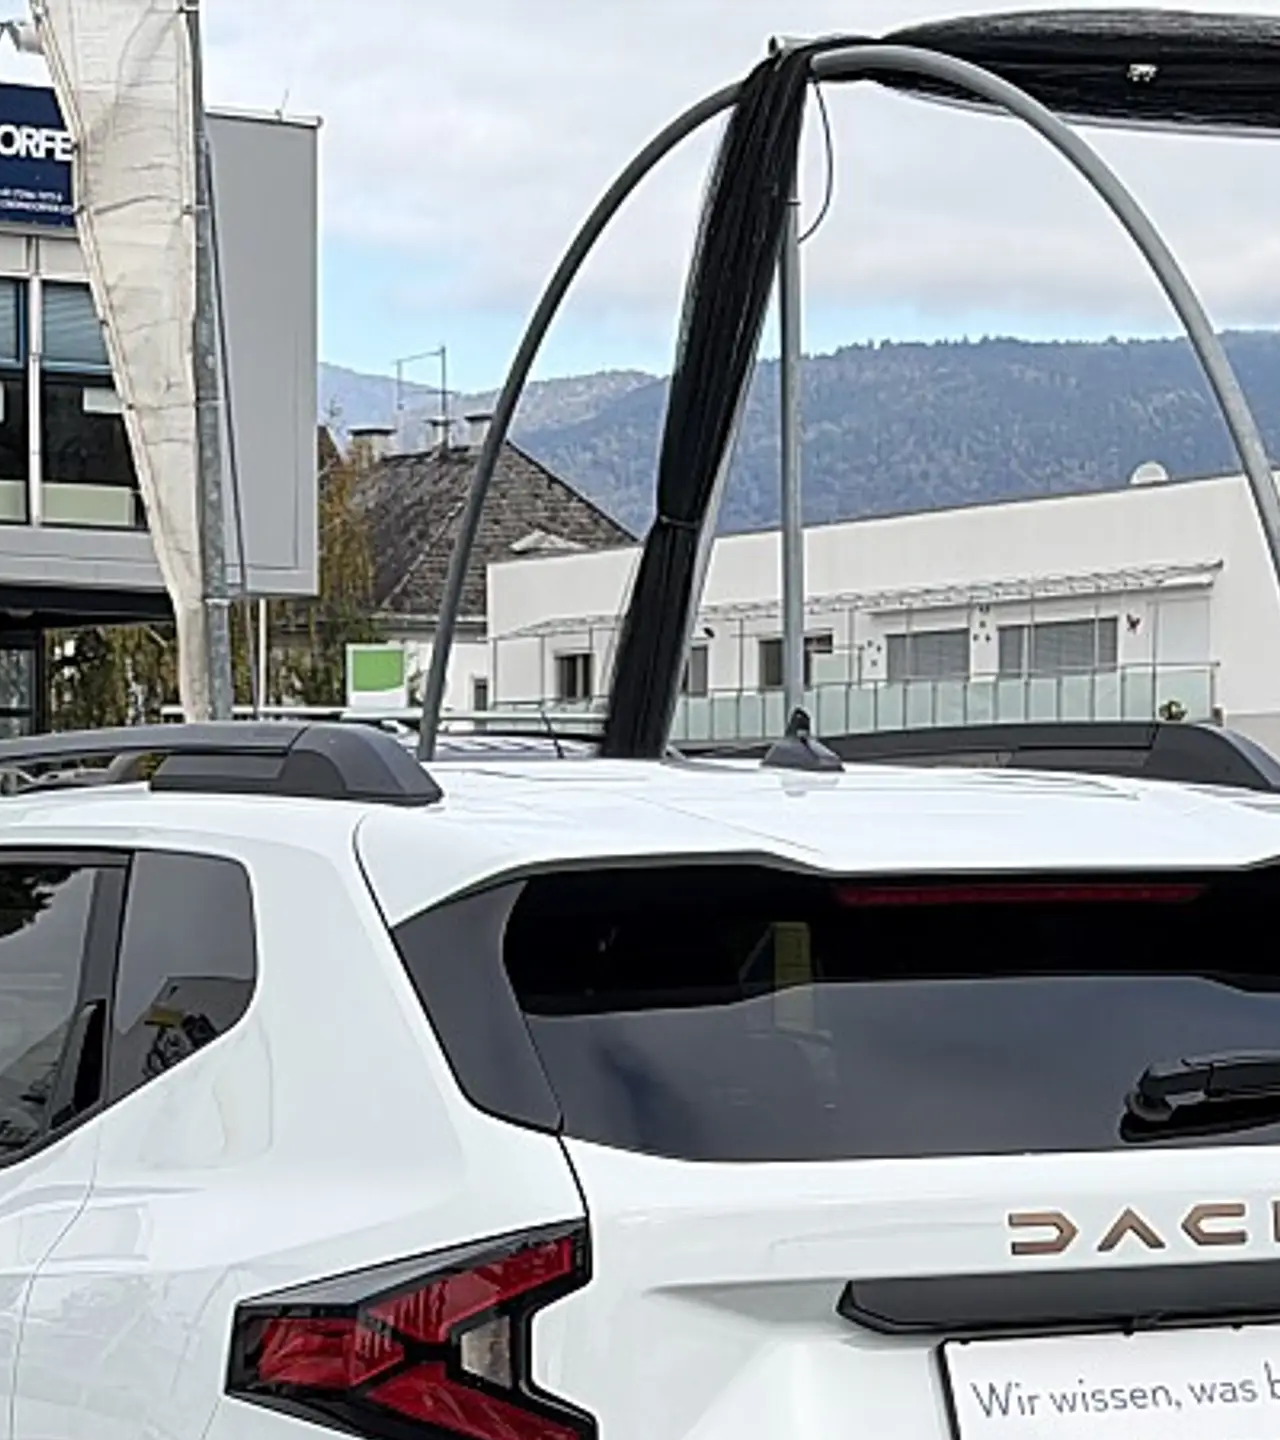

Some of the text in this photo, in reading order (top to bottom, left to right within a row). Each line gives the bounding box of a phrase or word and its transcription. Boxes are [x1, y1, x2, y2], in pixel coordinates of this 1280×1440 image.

[970, 1382, 1040, 1418] Wir
[1049, 1378, 1183, 1414] wissen,
[1187, 1378, 1259, 1405] was
